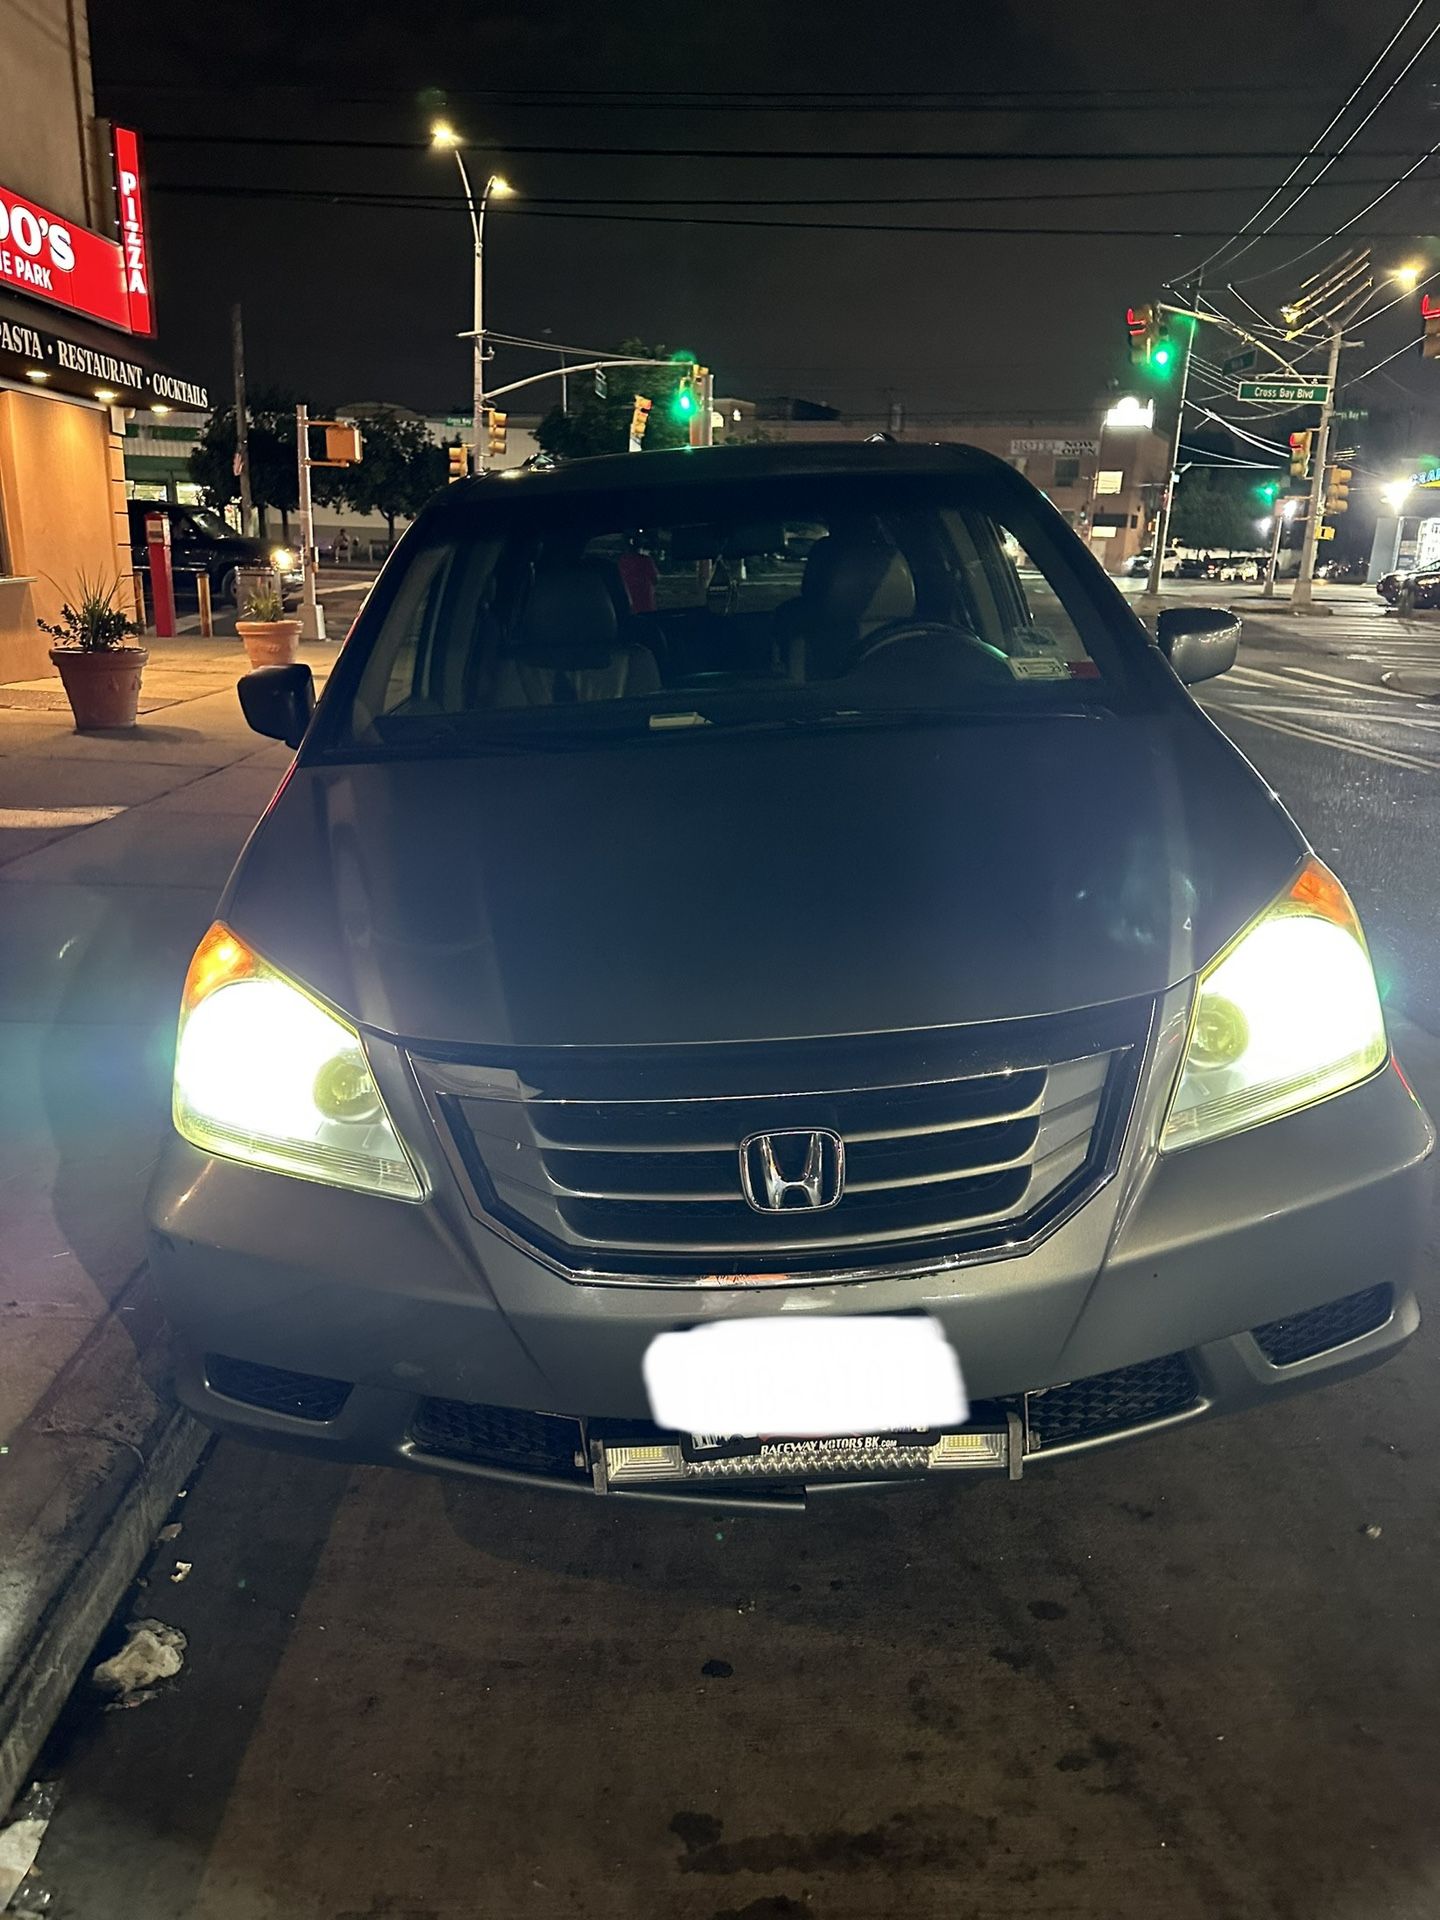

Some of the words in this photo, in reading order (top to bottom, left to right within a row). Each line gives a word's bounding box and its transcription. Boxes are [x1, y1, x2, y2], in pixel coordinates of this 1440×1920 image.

[121, 170, 147, 294] PIZZA
[15, 255, 53, 291] PARK
[0, 321, 44, 360] ASTA
[57, 339, 143, 390] RESTAURANT
[153, 373, 208, 408] COCKTAILS
[1254, 387, 1276, 397] Cross
[1280, 387, 1294, 400] Bay
[1297, 388, 1314, 399] Blvd
[1061, 448, 1095, 457] OPEN
[1065, 440, 1093, 448] NOW
[761, 1440, 818, 1456] RACEWAY
[819, 1437, 864, 1450] MOTORS
